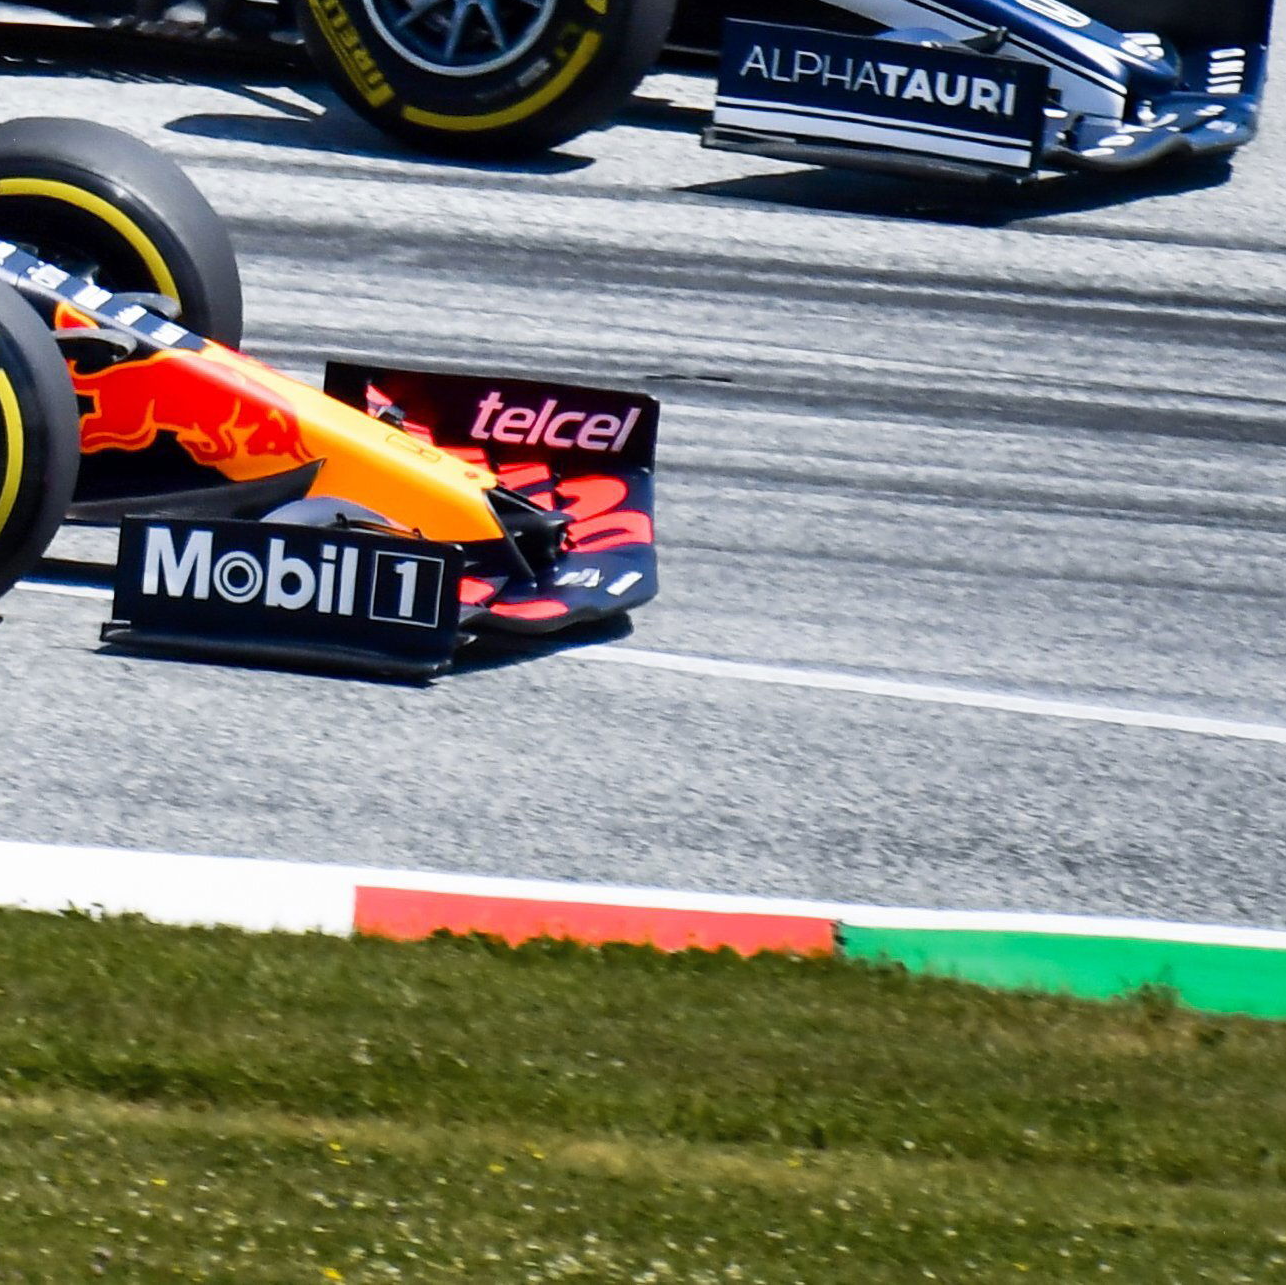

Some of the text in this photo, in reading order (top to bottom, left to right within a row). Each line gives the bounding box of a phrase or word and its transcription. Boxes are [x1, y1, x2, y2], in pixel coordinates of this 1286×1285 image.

[739, 43, 1019, 117] ALPHATAURI
[469, 390, 643, 454] telcel
[140, 525, 419, 618] Mobil 1
